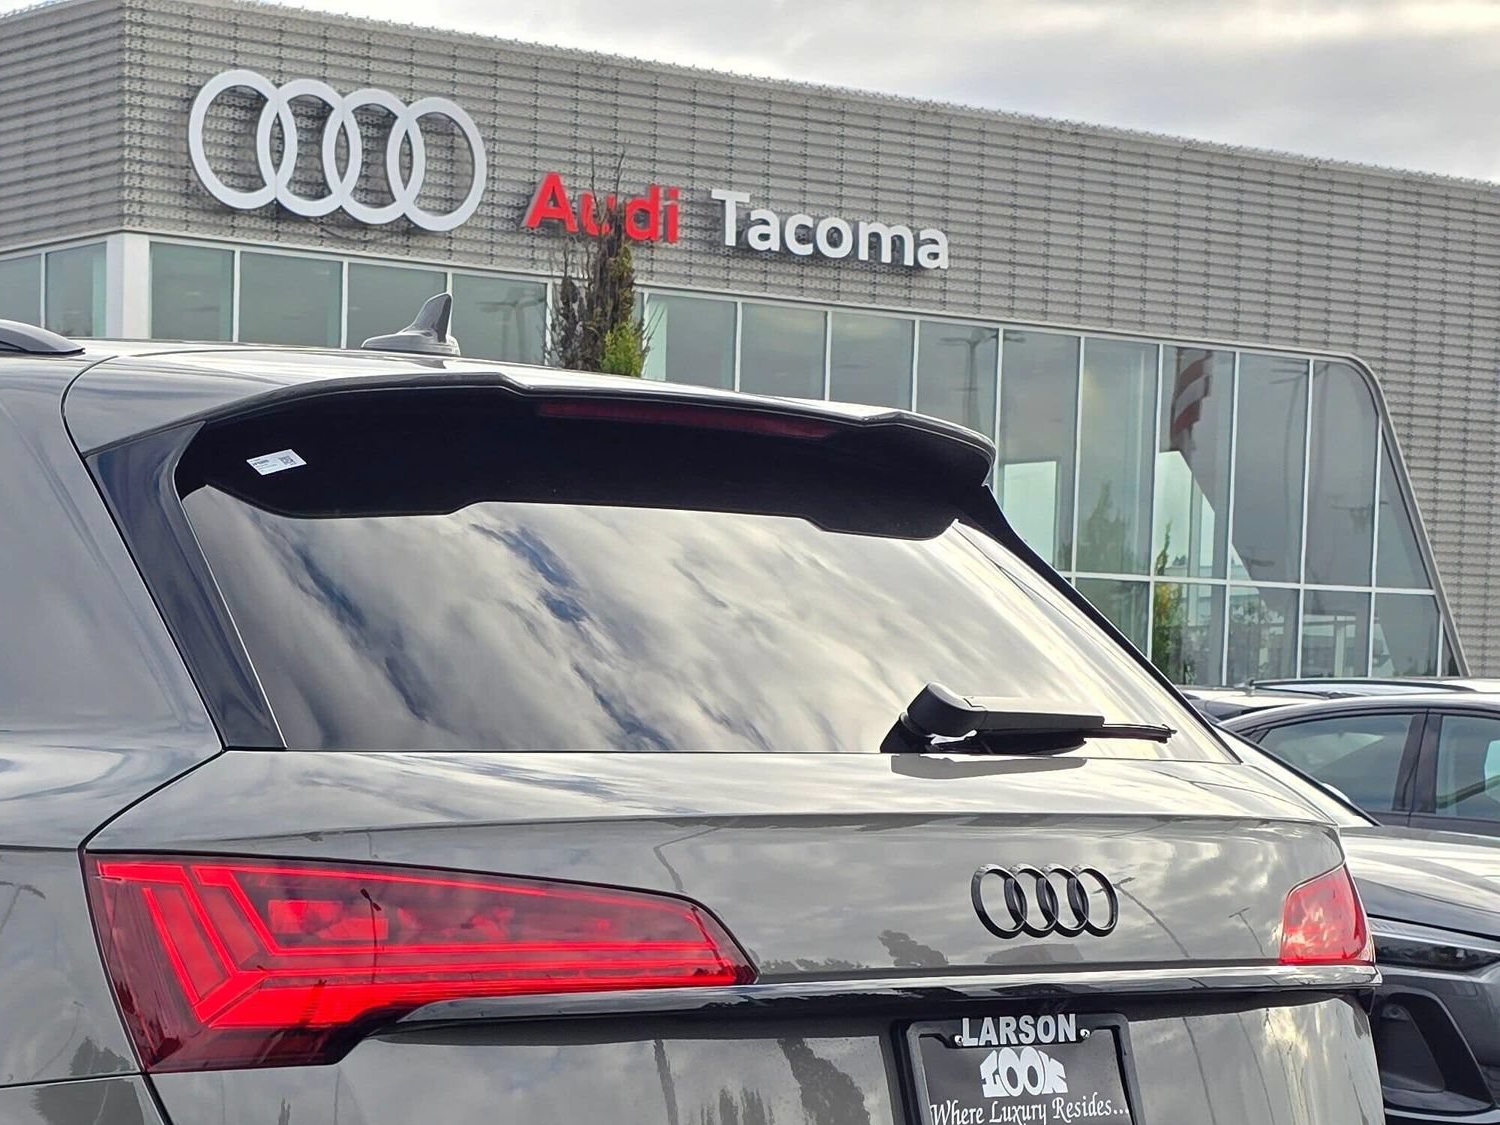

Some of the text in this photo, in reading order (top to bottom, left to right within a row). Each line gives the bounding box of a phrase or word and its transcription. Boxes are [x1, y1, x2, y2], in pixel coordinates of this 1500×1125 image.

[523, 171, 950, 270] Audi Tacoma
[961, 1013, 1077, 1046] LARSON
